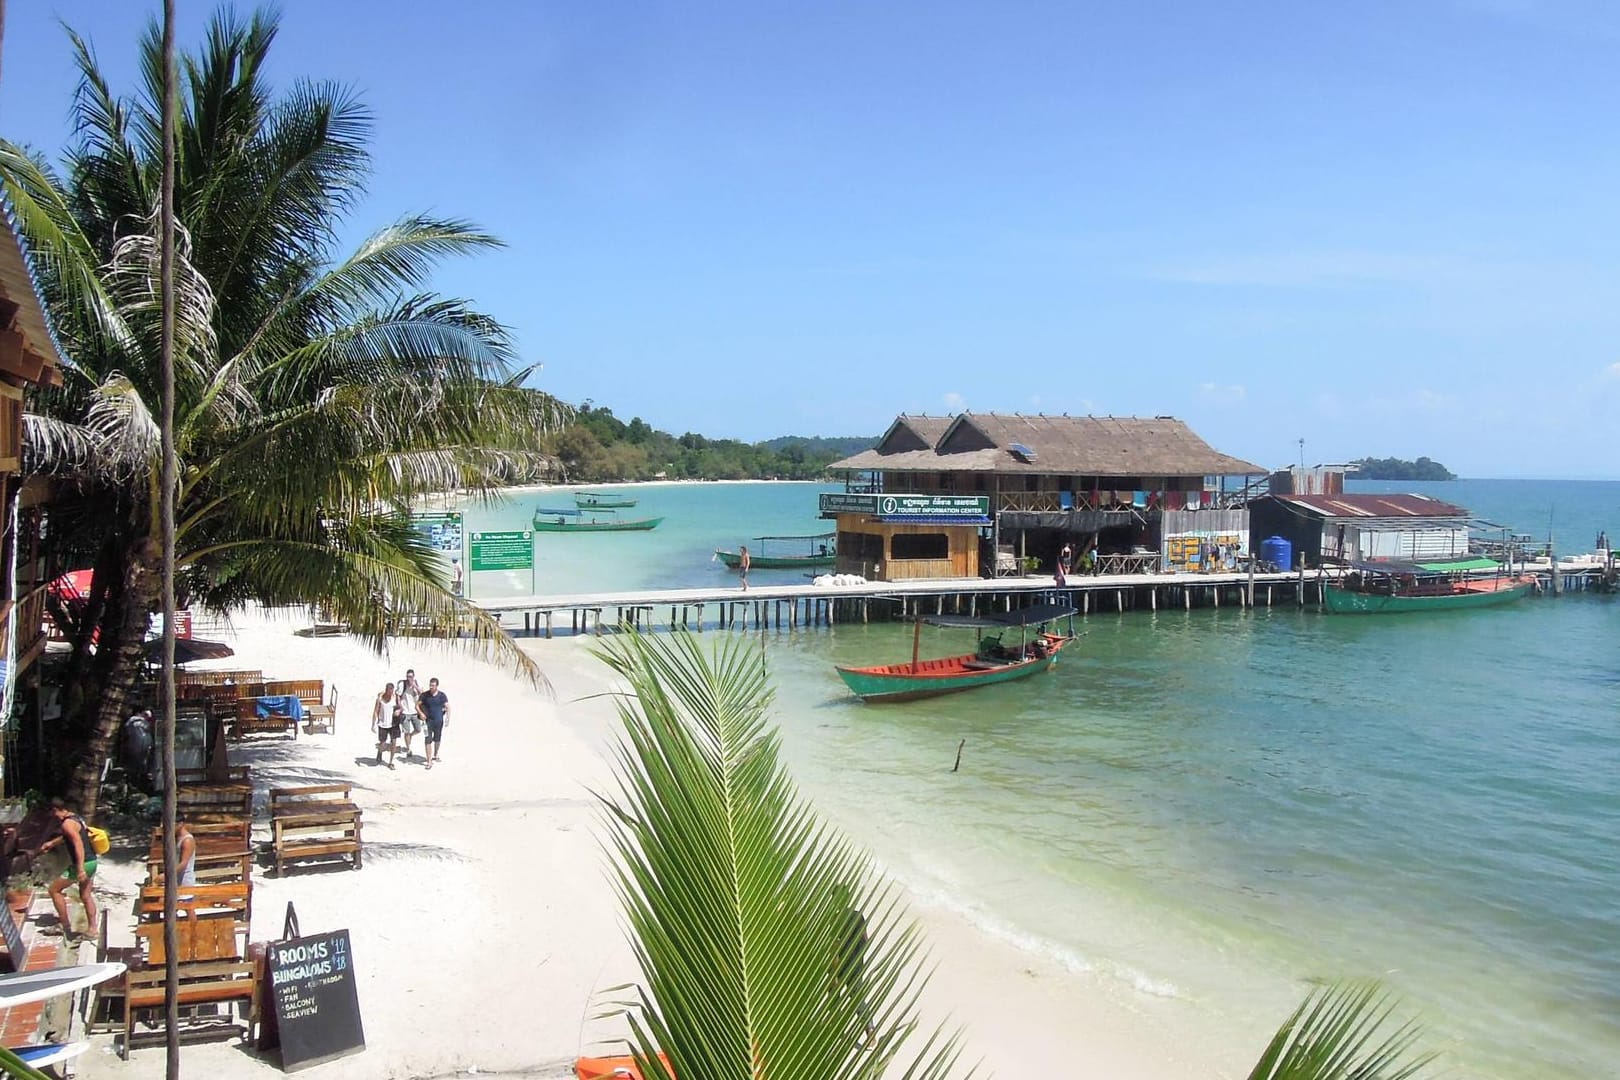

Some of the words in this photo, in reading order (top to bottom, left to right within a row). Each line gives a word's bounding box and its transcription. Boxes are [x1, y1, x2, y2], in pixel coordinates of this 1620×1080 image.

[279, 942, 328, 965] ROOMS
[272, 961, 332, 986] BUNGALOWS
[284, 993, 298, 1003] FAN
[285, 996, 315, 1011] BALCONY
